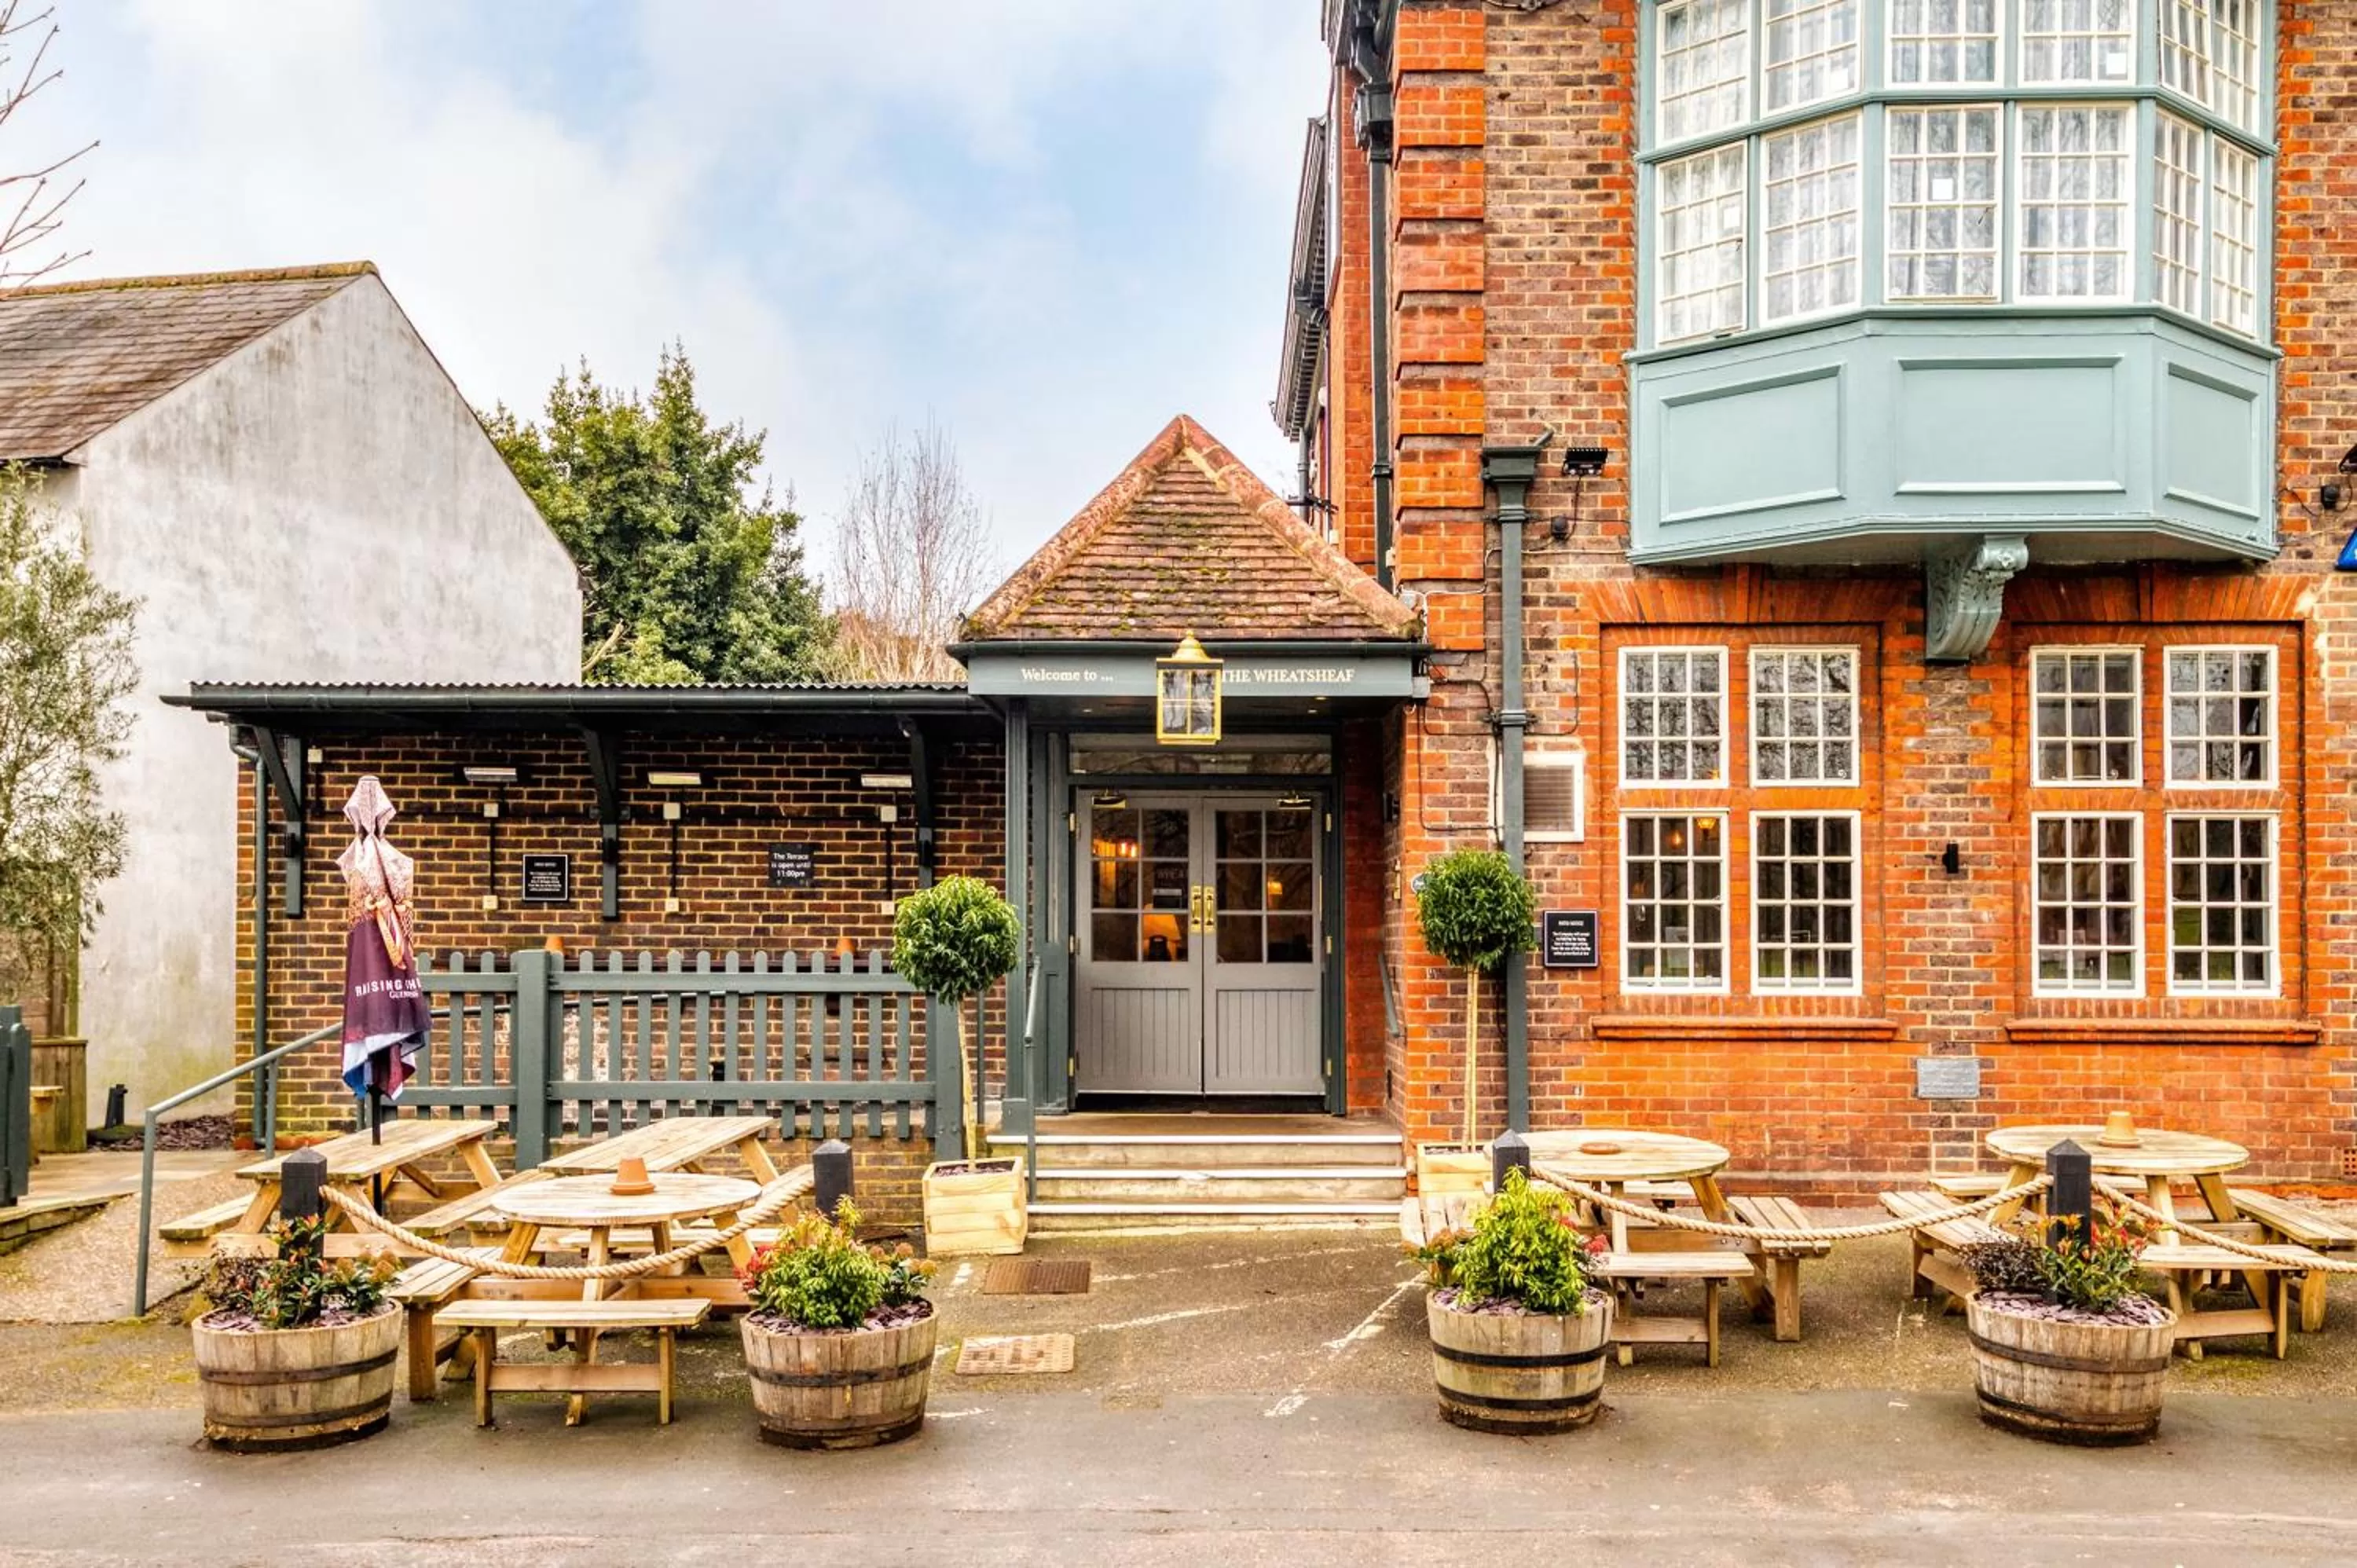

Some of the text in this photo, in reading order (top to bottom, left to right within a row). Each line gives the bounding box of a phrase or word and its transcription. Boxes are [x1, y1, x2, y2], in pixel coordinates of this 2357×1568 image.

[1021, 668, 1080, 682] Welcome
[1084, 669, 1098, 682] to
[1222, 669, 1355, 683] THE WHEATSHEAF
